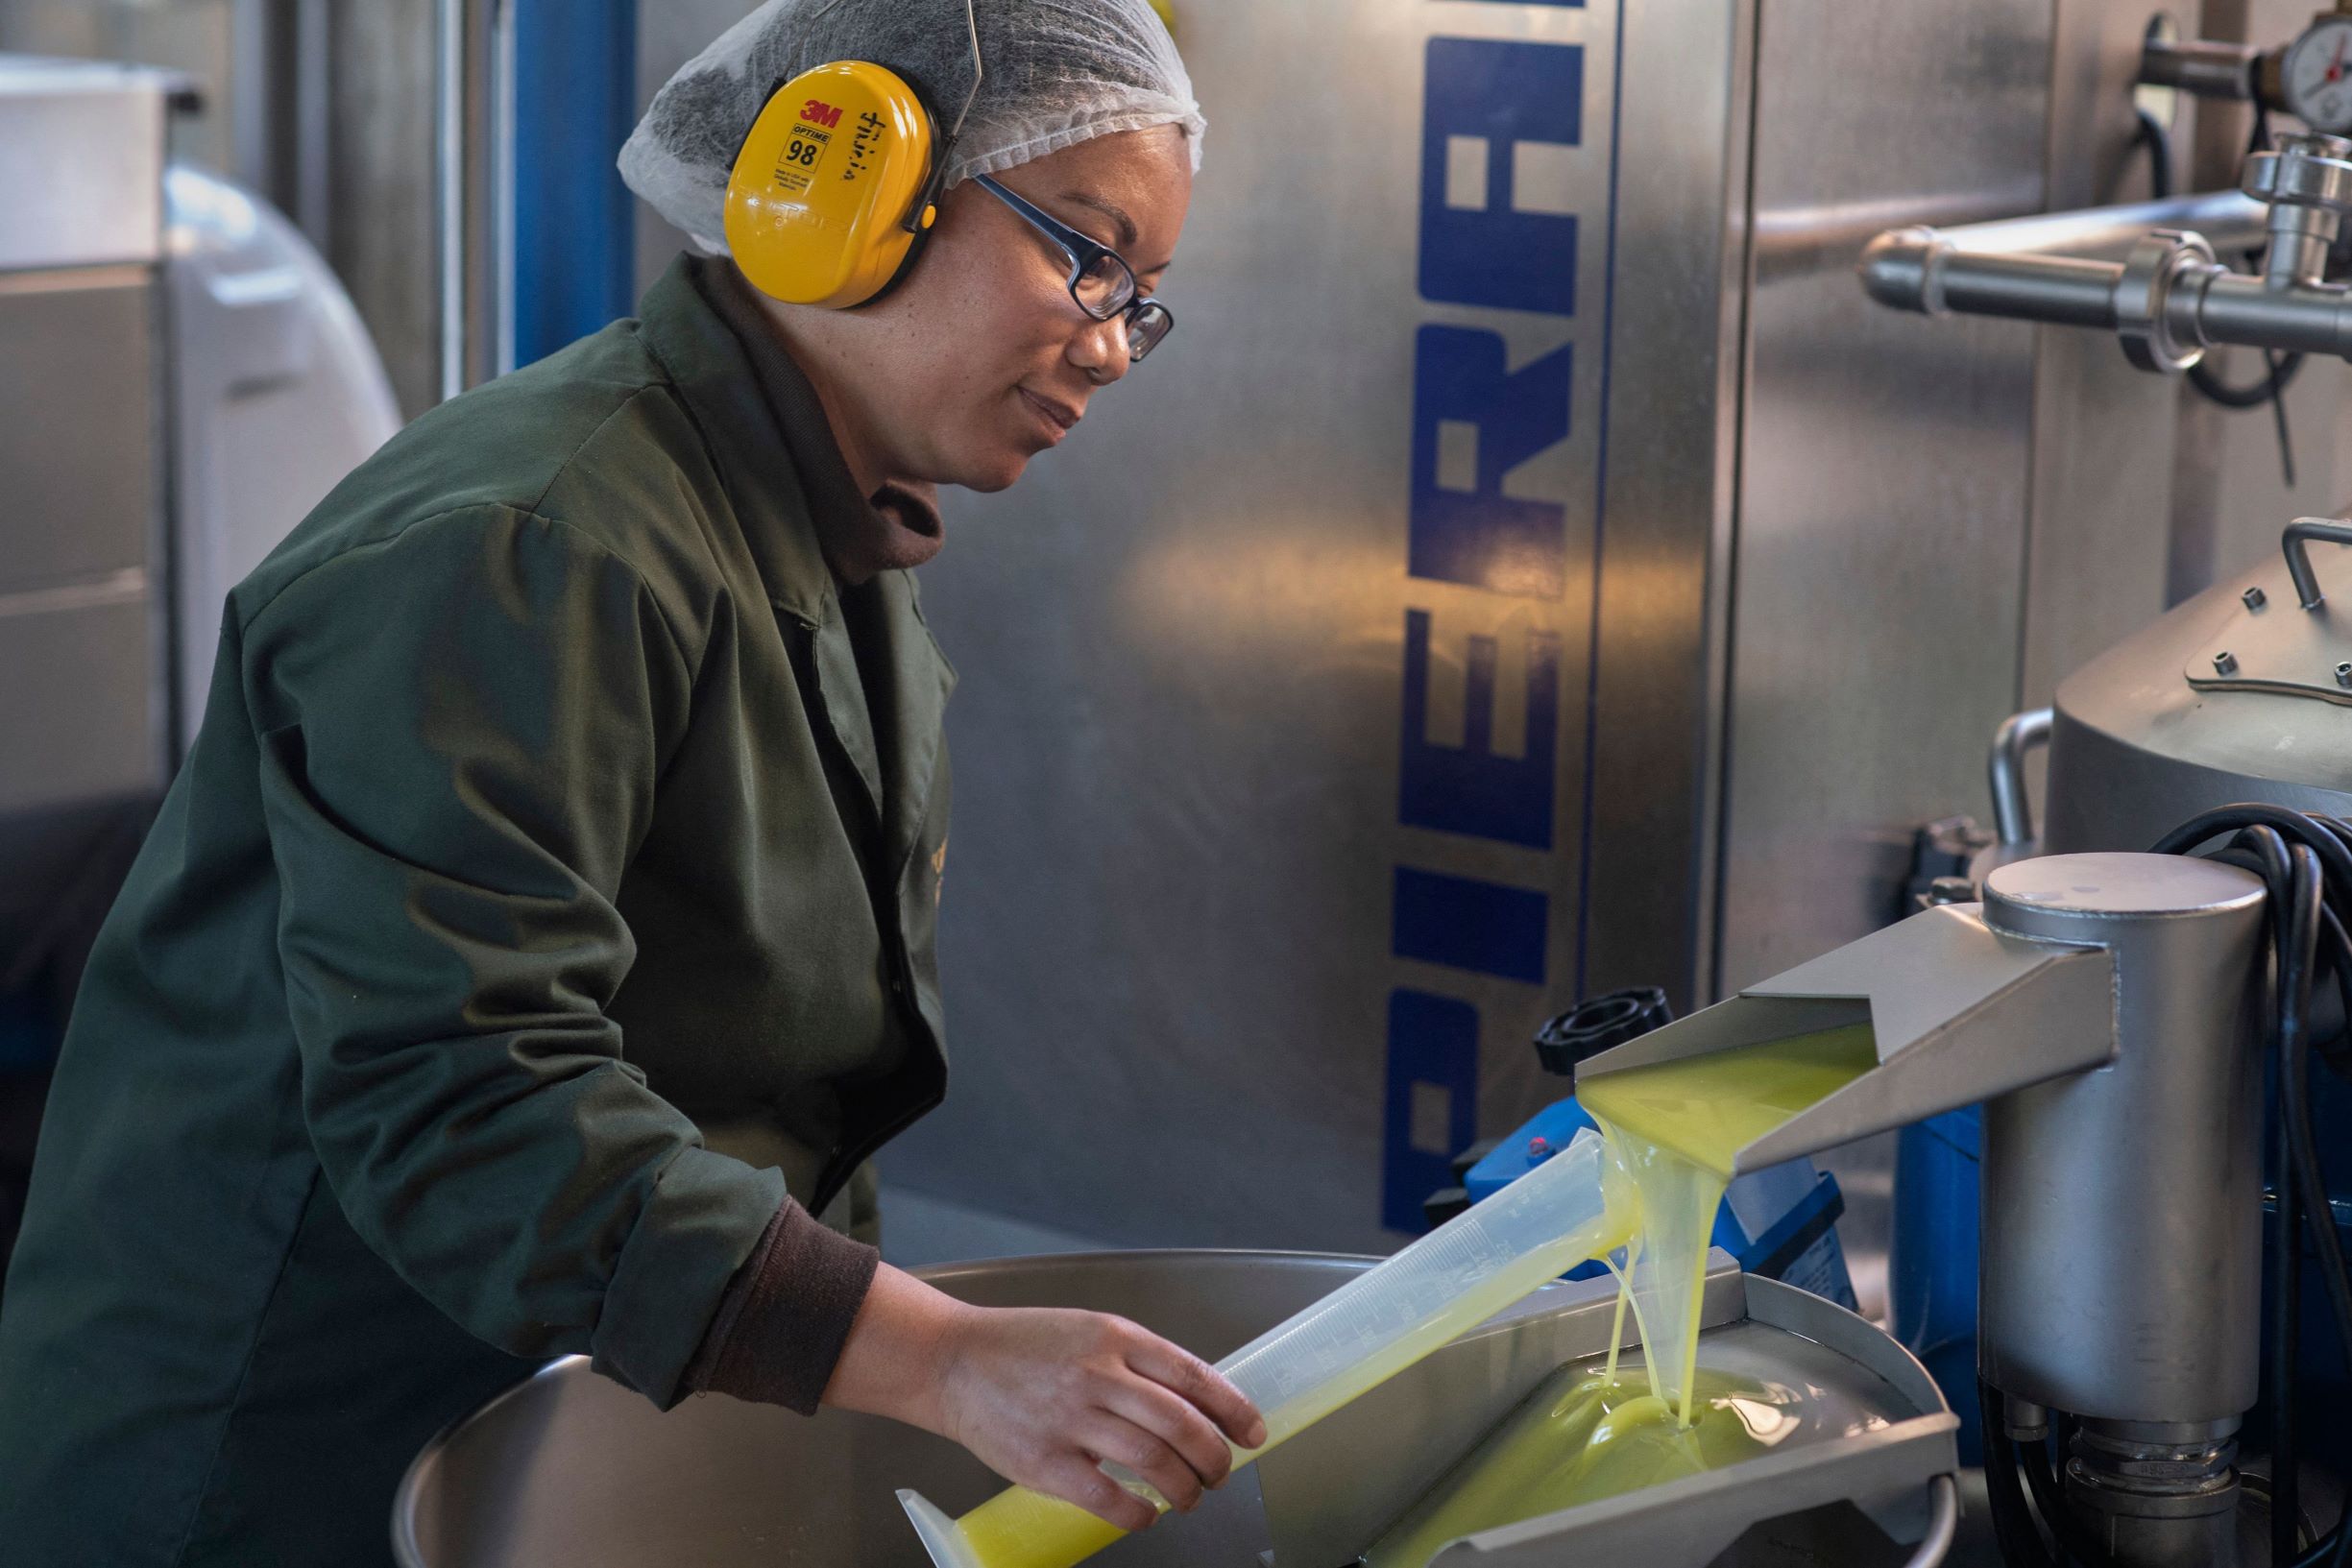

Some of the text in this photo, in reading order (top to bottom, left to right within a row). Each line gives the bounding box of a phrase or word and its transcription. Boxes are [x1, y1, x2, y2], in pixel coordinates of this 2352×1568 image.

[799, 100, 843, 129] 3M
[793, 125, 830, 143] OPTIME
[786, 140, 817, 166] 98
[1381, 0, 1587, 1233] PIERA
